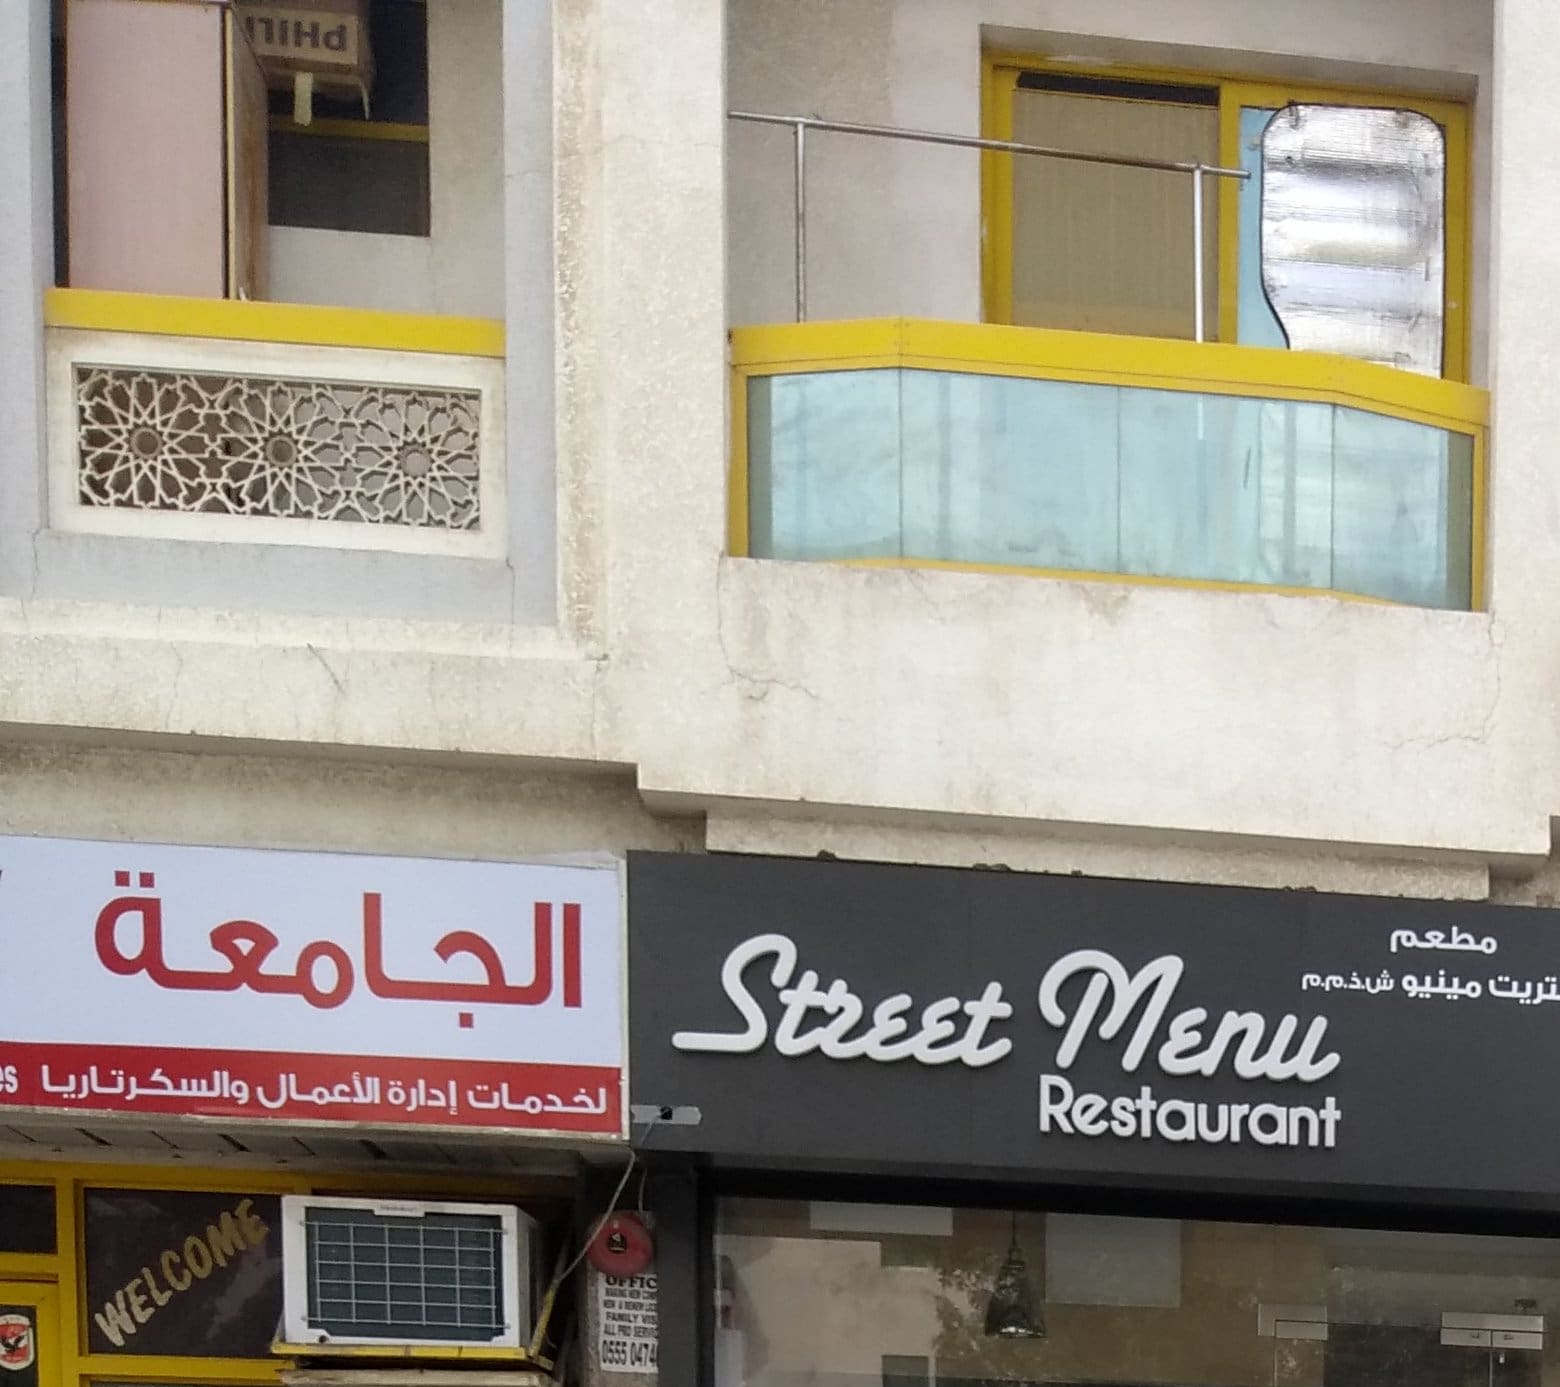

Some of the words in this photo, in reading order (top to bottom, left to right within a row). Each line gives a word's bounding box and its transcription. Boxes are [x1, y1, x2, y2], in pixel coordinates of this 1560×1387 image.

[94, 870, 583, 1029] الجامعة
[1390, 926, 1498, 954] مطعم
[1402, 969, 1482, 1000] مينيو
[671, 933, 1013, 1068] Street
[1038, 949, 1342, 1082] Menu
[41, 1064, 249, 1104] والسكرتاريا
[257, 1071, 380, 1109] الأعمال
[386, 1079, 458, 1115] إدارة
[466, 1082, 607, 1114] لخدمات
[1039, 1075, 1342, 1148] Restaurant
[94, 1198, 271, 1348] WELCOME
[602, 1340, 627, 1365] 0555
[630, 1342, 658, 1367] 0474
